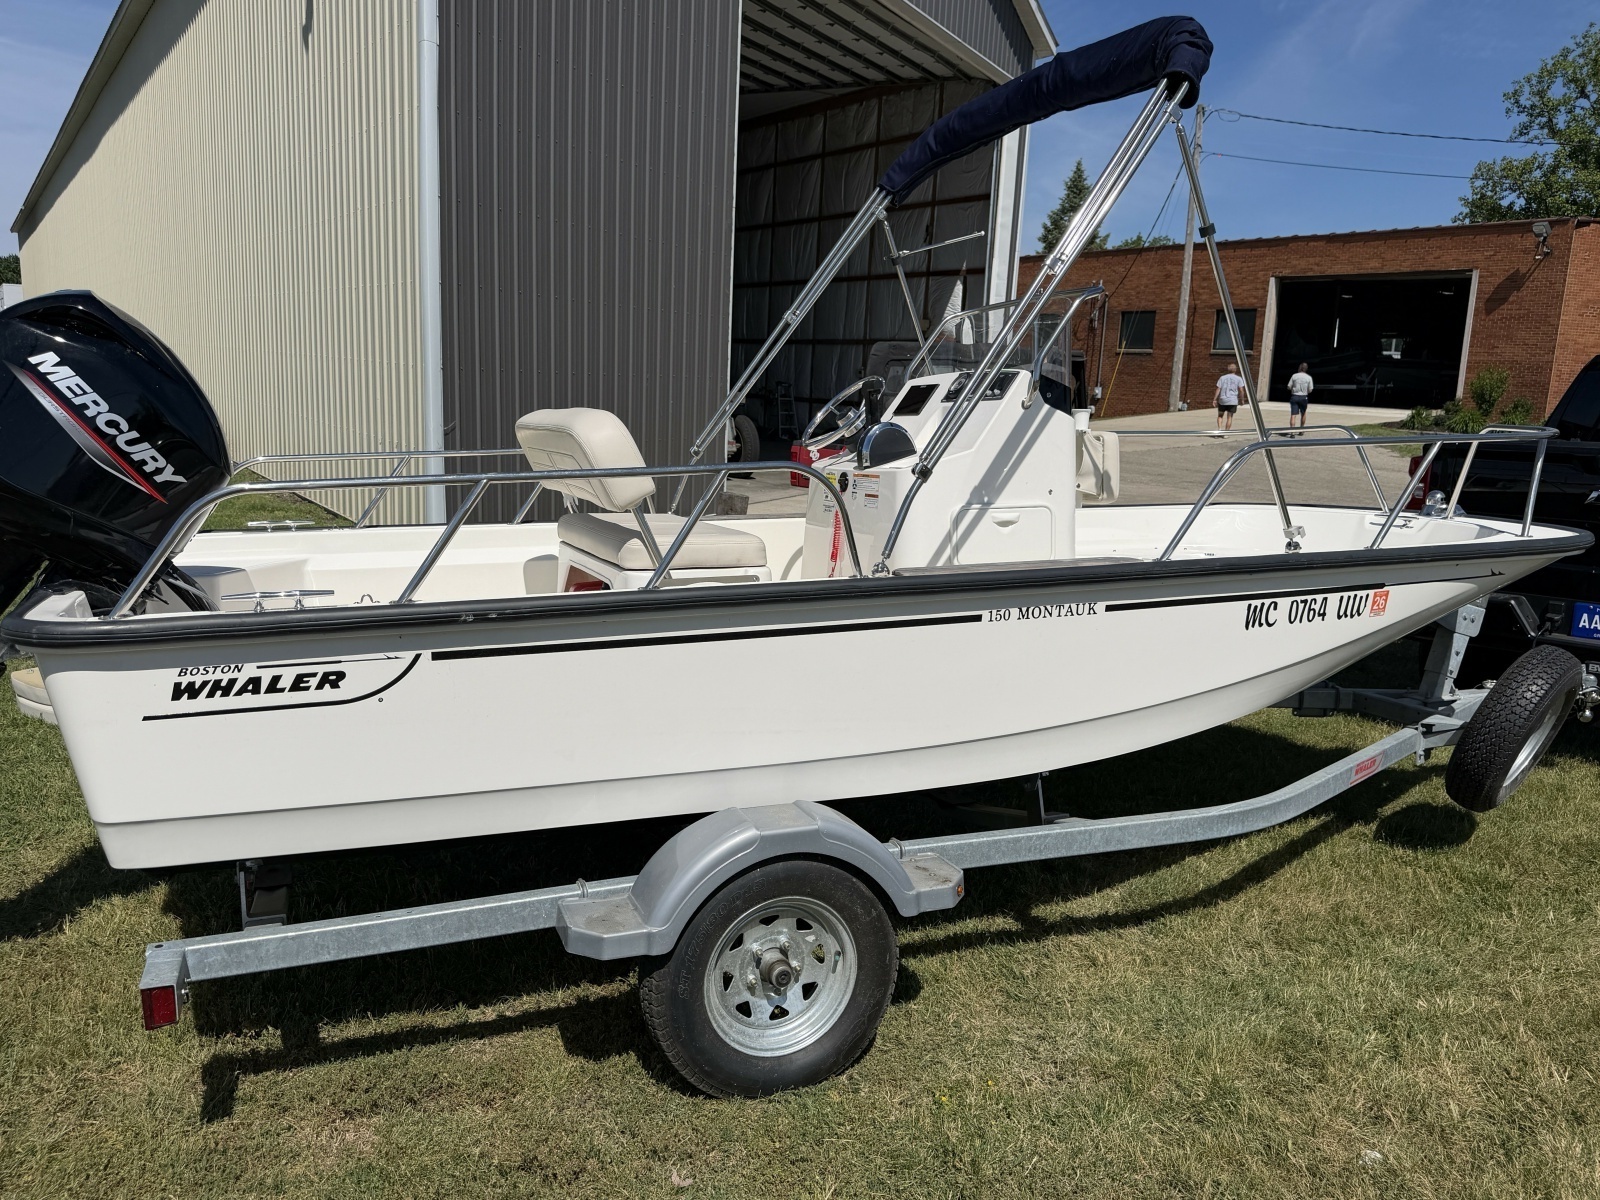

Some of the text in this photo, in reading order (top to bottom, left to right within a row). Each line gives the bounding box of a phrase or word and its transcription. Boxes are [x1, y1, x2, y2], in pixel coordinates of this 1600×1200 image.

[27, 352, 188, 483] MERCURY
[988, 602, 1098, 623] 150 MONTAUK
[1245, 593, 1369, 631] MC 0764 UW
[1373, 595, 1386, 610] 26
[177, 664, 245, 678] BOSTON
[170, 670, 347, 702] WHALER
